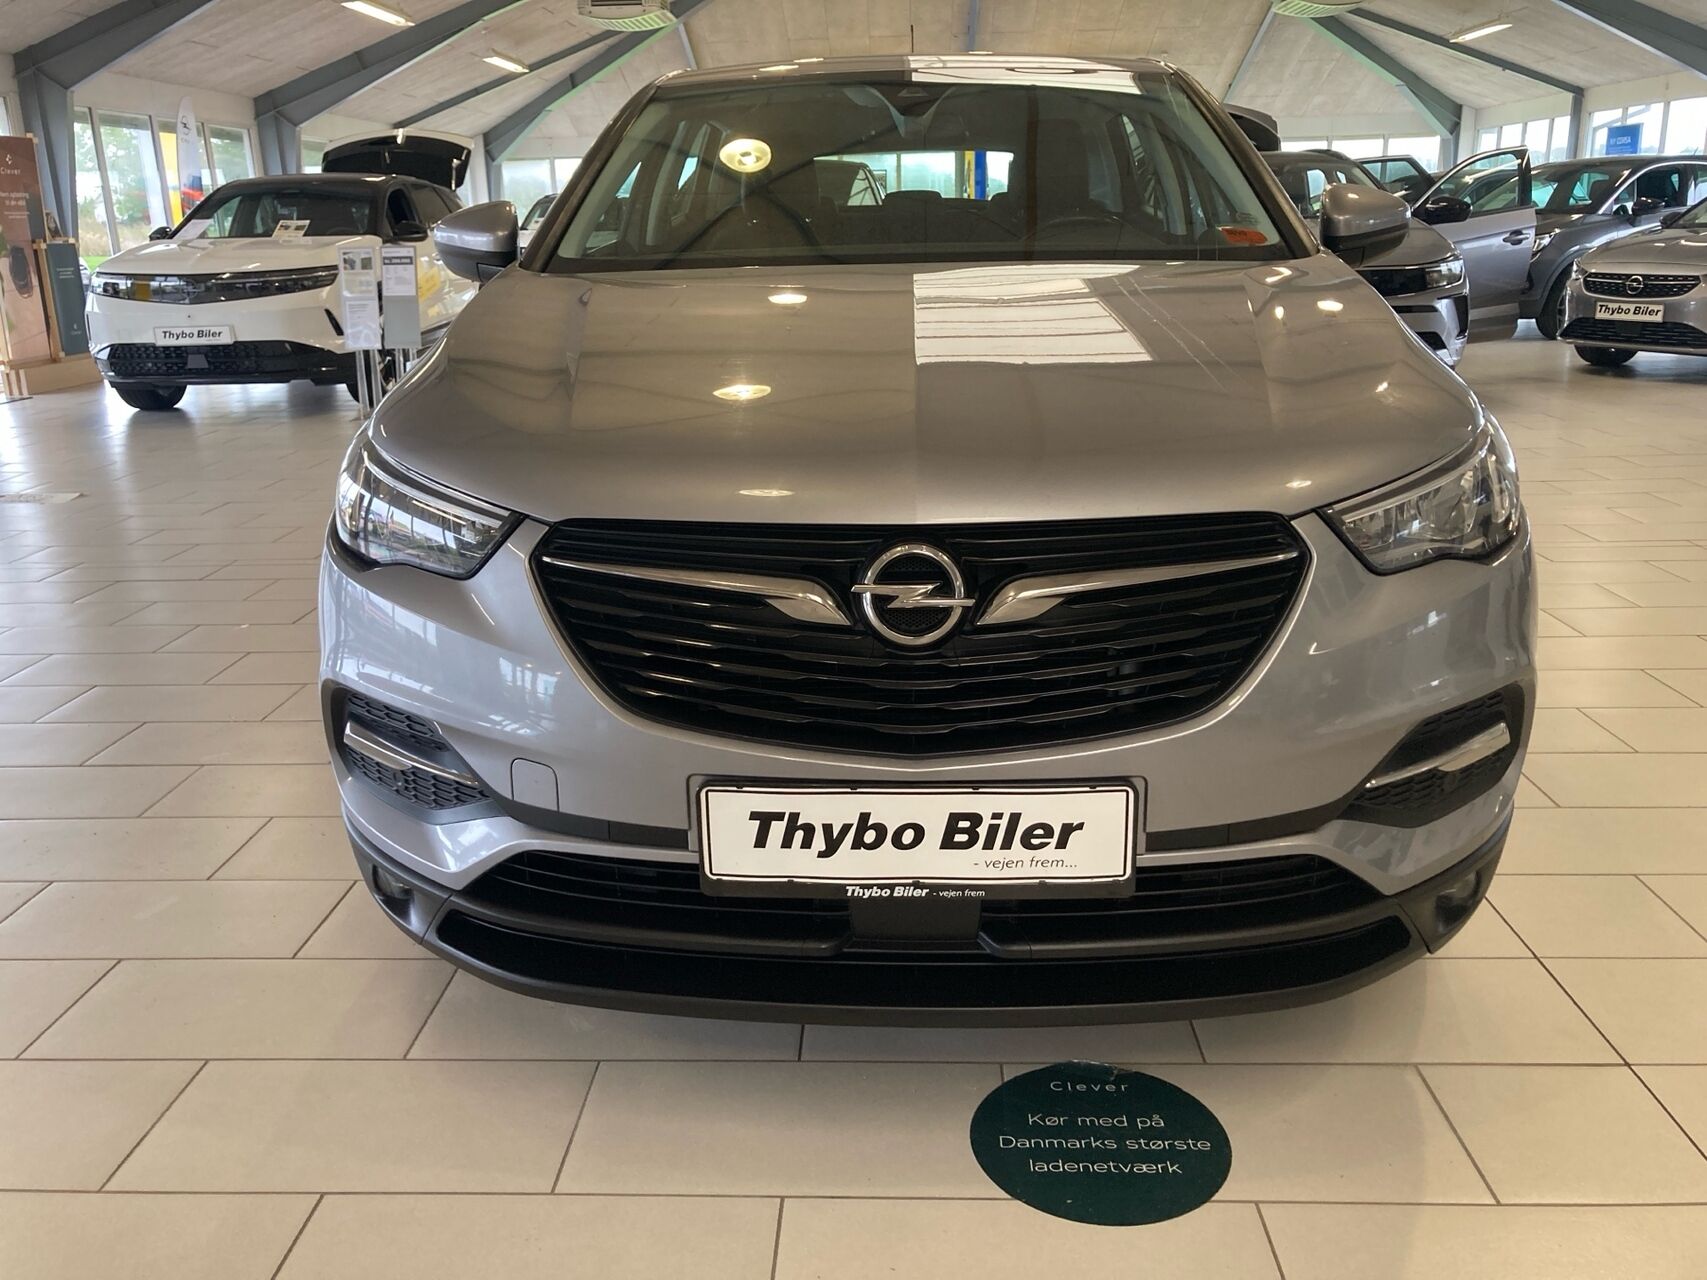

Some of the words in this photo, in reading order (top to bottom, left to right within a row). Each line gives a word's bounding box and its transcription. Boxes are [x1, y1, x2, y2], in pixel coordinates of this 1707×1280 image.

[1598, 304, 1631, 316] Thybo
[1633, 305, 1662, 316] Biler
[162, 330, 195, 341] Thybo
[197, 329, 223, 339] Biler
[748, 810, 926, 859] Thybo
[938, 811, 1085, 851] Biler
[983, 857, 1024, 871] vejen
[1029, 855, 1078, 869] frem...
[845, 886, 890, 899] Thybo
[893, 886, 929, 897] Biler
[938, 889, 962, 898] vejen
[964, 888, 986, 897] frem
[1050, 1081, 1129, 1092] Clever
[1027, 1113, 1068, 1127] Kør
[1078, 1114, 1128, 1127] med
[1136, 1114, 1165, 1130] på
[999, 1135, 1117, 1149] Danmarks
[1126, 1137, 1211, 1151] største
[1029, 1159, 1183, 1174] ladenetværk
